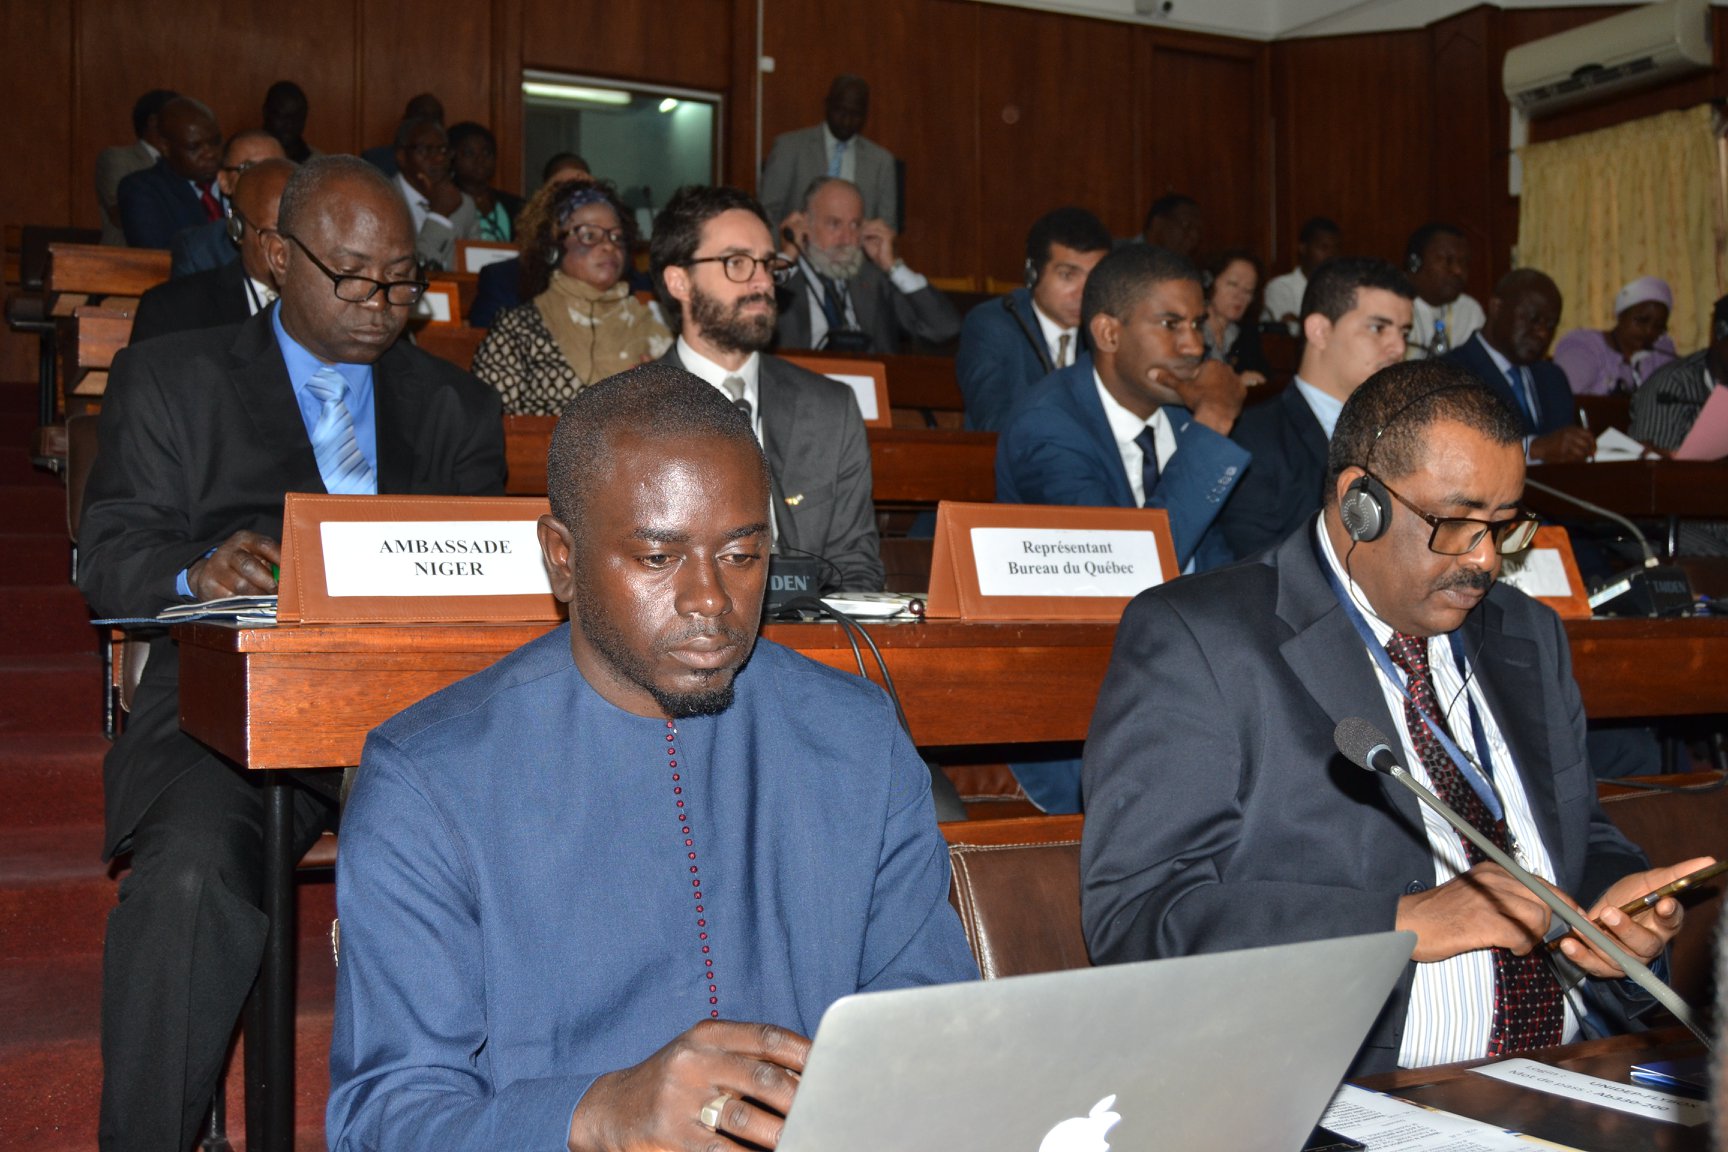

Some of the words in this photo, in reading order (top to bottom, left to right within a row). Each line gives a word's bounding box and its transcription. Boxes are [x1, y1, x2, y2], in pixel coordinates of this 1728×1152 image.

[380, 539, 512, 554] AMBASSADE
[1022, 540, 1113, 556] Représentant
[415, 561, 484, 576] NIGER
[1008, 561, 1061, 576] Bureau
[1064, 562, 1081, 576] du
[1085, 562, 1135, 577] Québec
[770, 575, 807, 591] DEN
[1525, 1065, 1559, 1076] Login
[1509, 1069, 1536, 1079] Mot
[1554, 1082, 1586, 1092] pass
